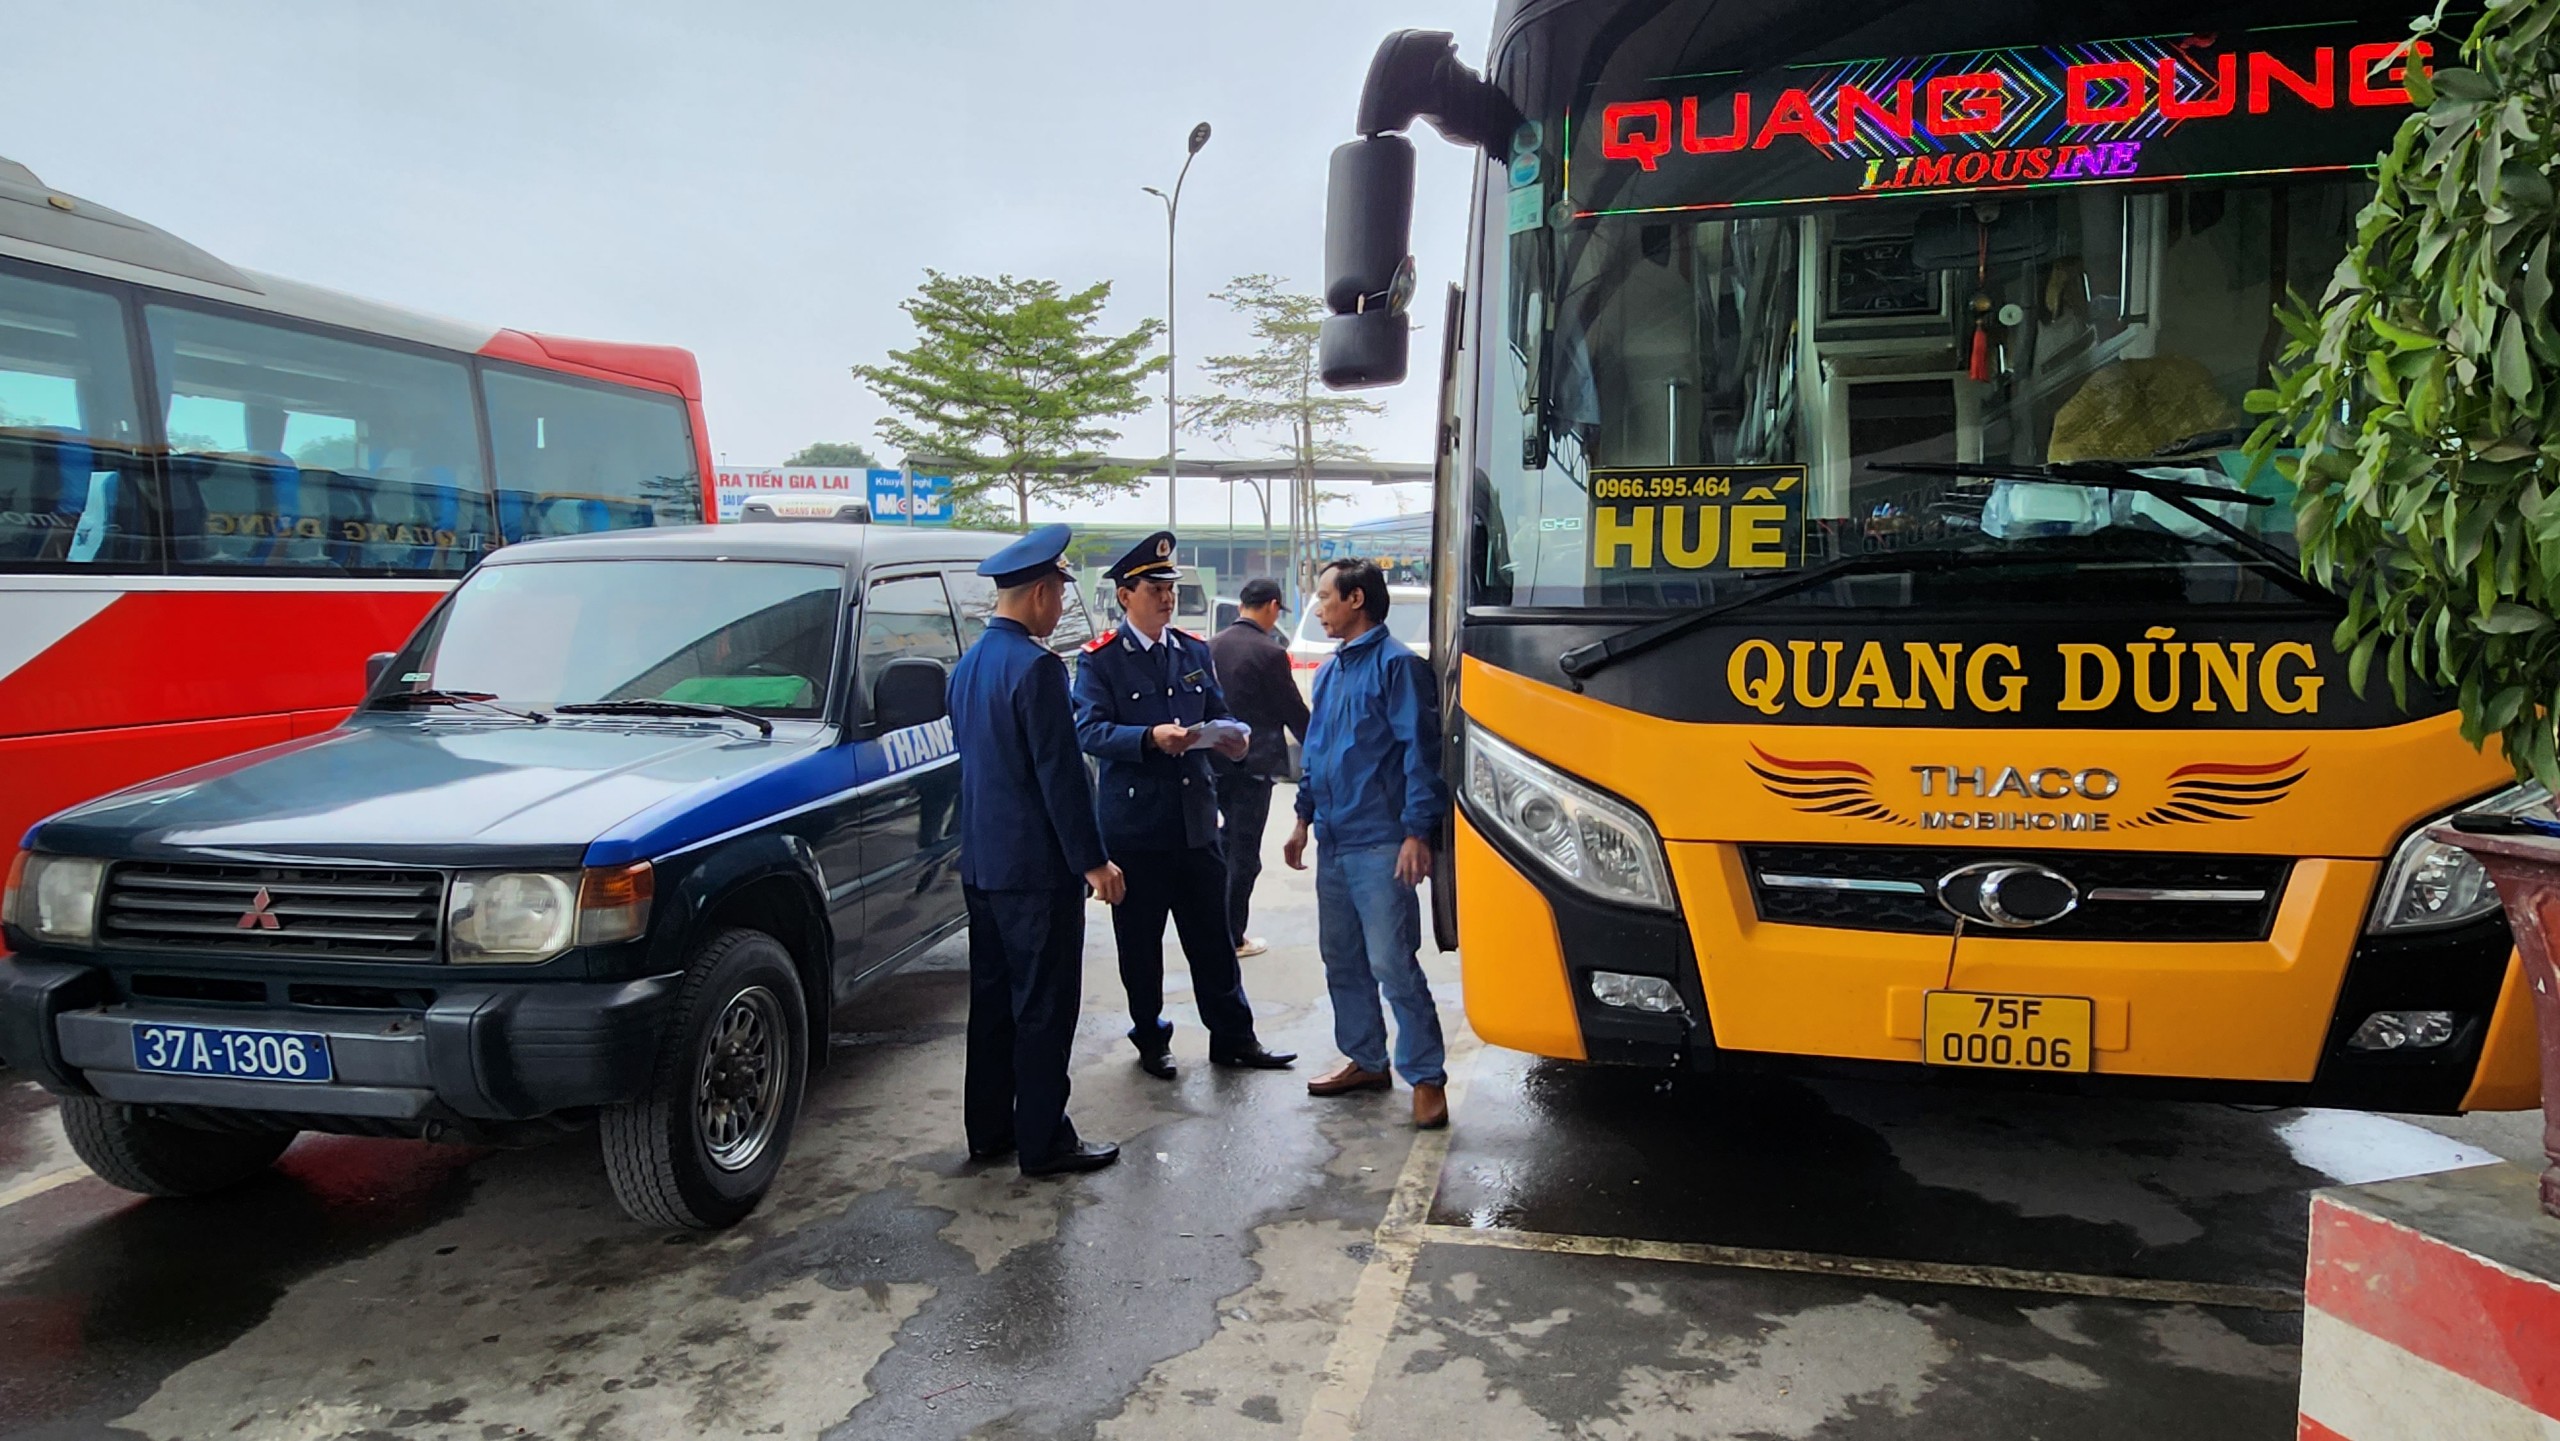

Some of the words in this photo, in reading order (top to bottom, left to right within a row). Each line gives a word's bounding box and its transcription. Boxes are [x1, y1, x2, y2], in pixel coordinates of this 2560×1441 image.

[1603, 72, 2003, 172] QUANG
[2066, 33, 2434, 126] DŨNG
[1858, 141, 2140, 191] LIMOUSINE
[746, 469, 783, 488] TIẾN
[789, 475, 817, 489] GIA
[822, 475, 849, 489] LAI
[1596, 476, 1731, 498] 0966.595.464
[1594, 477, 1800, 568] HUẾ
[1726, 639, 2028, 714] QUANG
[2056, 626, 2323, 713] DŨNG
[1911, 765, 2120, 798] THACO
[1920, 812, 2110, 832] MOBIHOME
[1974, 998, 2042, 1030] 75F
[143, 1029, 307, 1076] 37A-1306
[1943, 1032, 2071, 1068] 000.06
